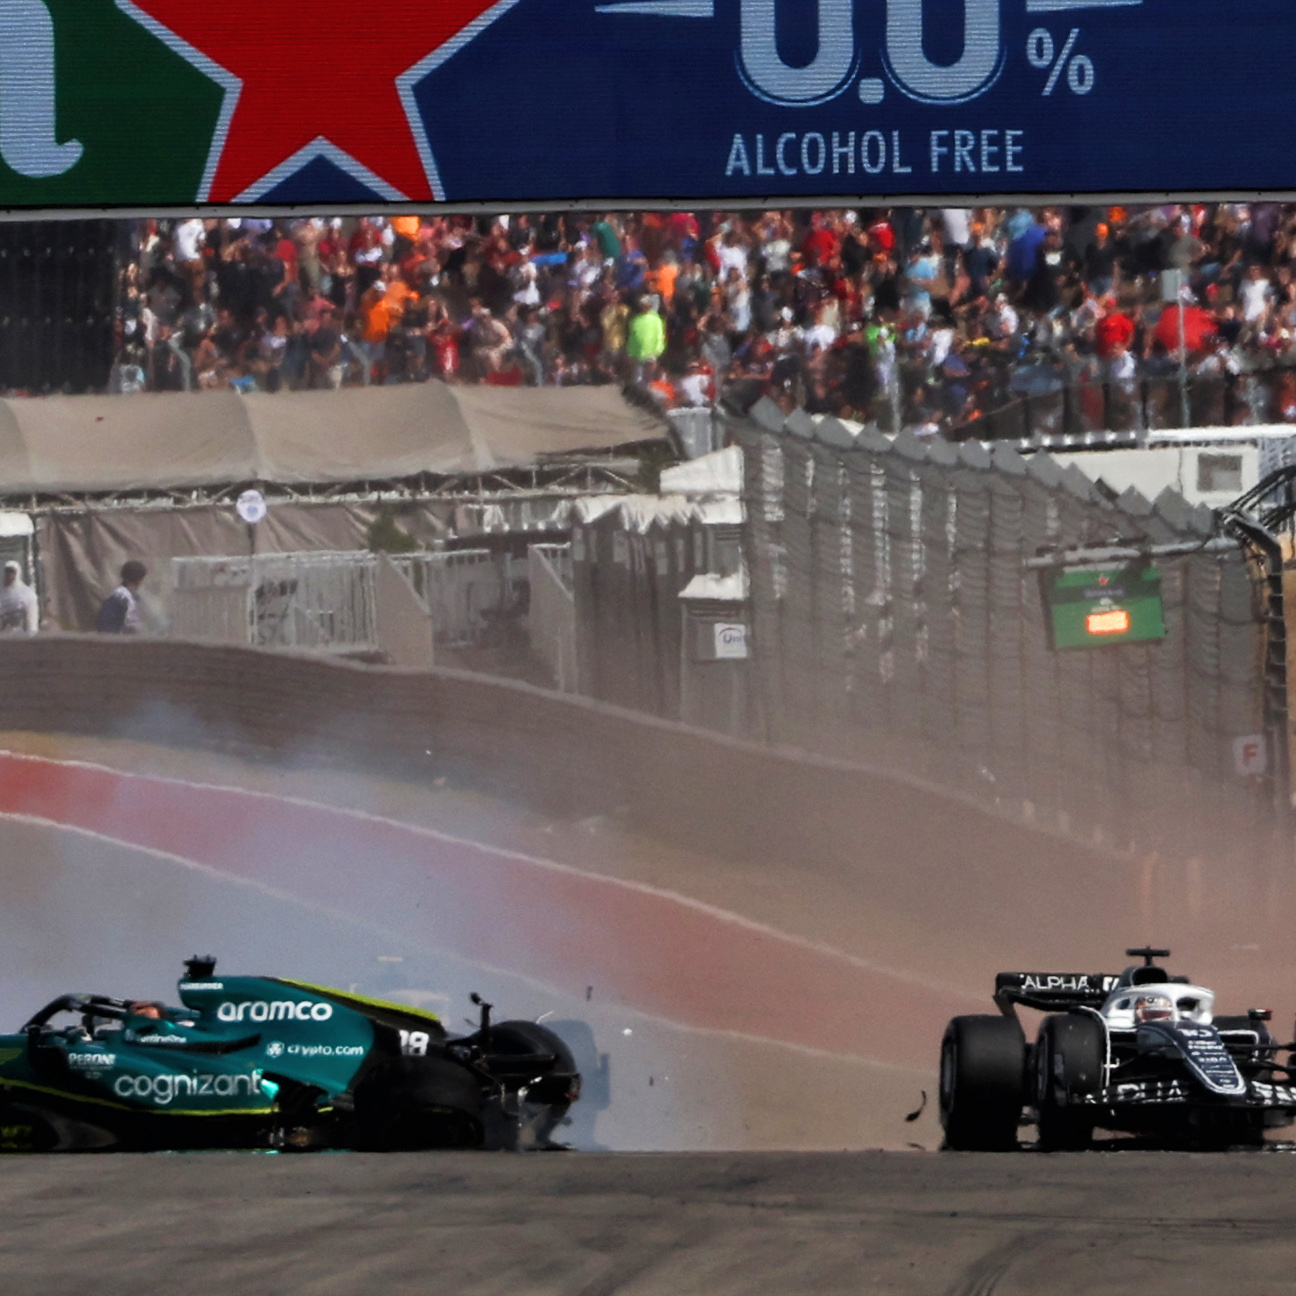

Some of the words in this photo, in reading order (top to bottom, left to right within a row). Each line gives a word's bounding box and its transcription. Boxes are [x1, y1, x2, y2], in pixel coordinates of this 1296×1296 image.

[725, 130, 913, 177] ALCOHOL
[930, 129, 1025, 174] FREE
[1243, 744, 1259, 765] F
[1024, 975, 1089, 990] ALPHA
[217, 1000, 334, 1022] aramco
[286, 1044, 364, 1056] crypto.com
[398, 1029, 430, 1057] 18
[114, 1069, 261, 1105] cognizant
